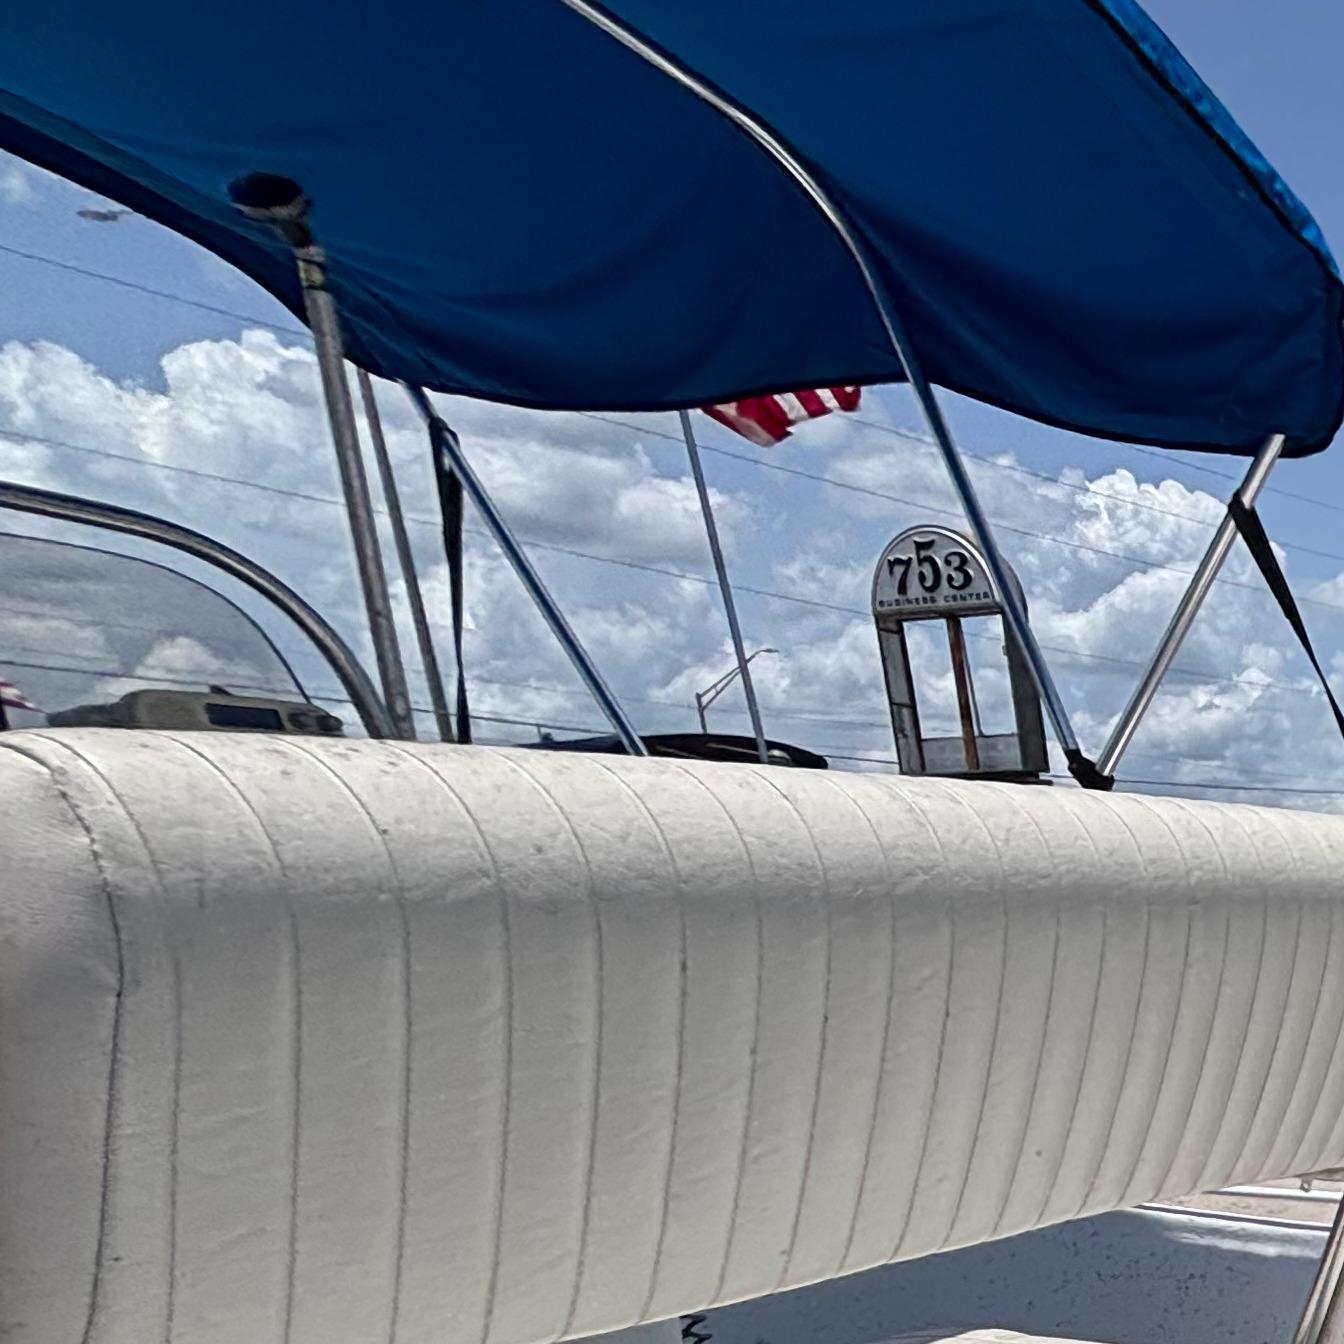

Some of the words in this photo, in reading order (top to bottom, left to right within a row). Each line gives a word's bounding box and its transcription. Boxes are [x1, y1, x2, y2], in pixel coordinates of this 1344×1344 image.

[886, 537, 973, 596] 753
[878, 596, 937, 608] BUSINESS
[943, 592, 990, 604] CENTER
